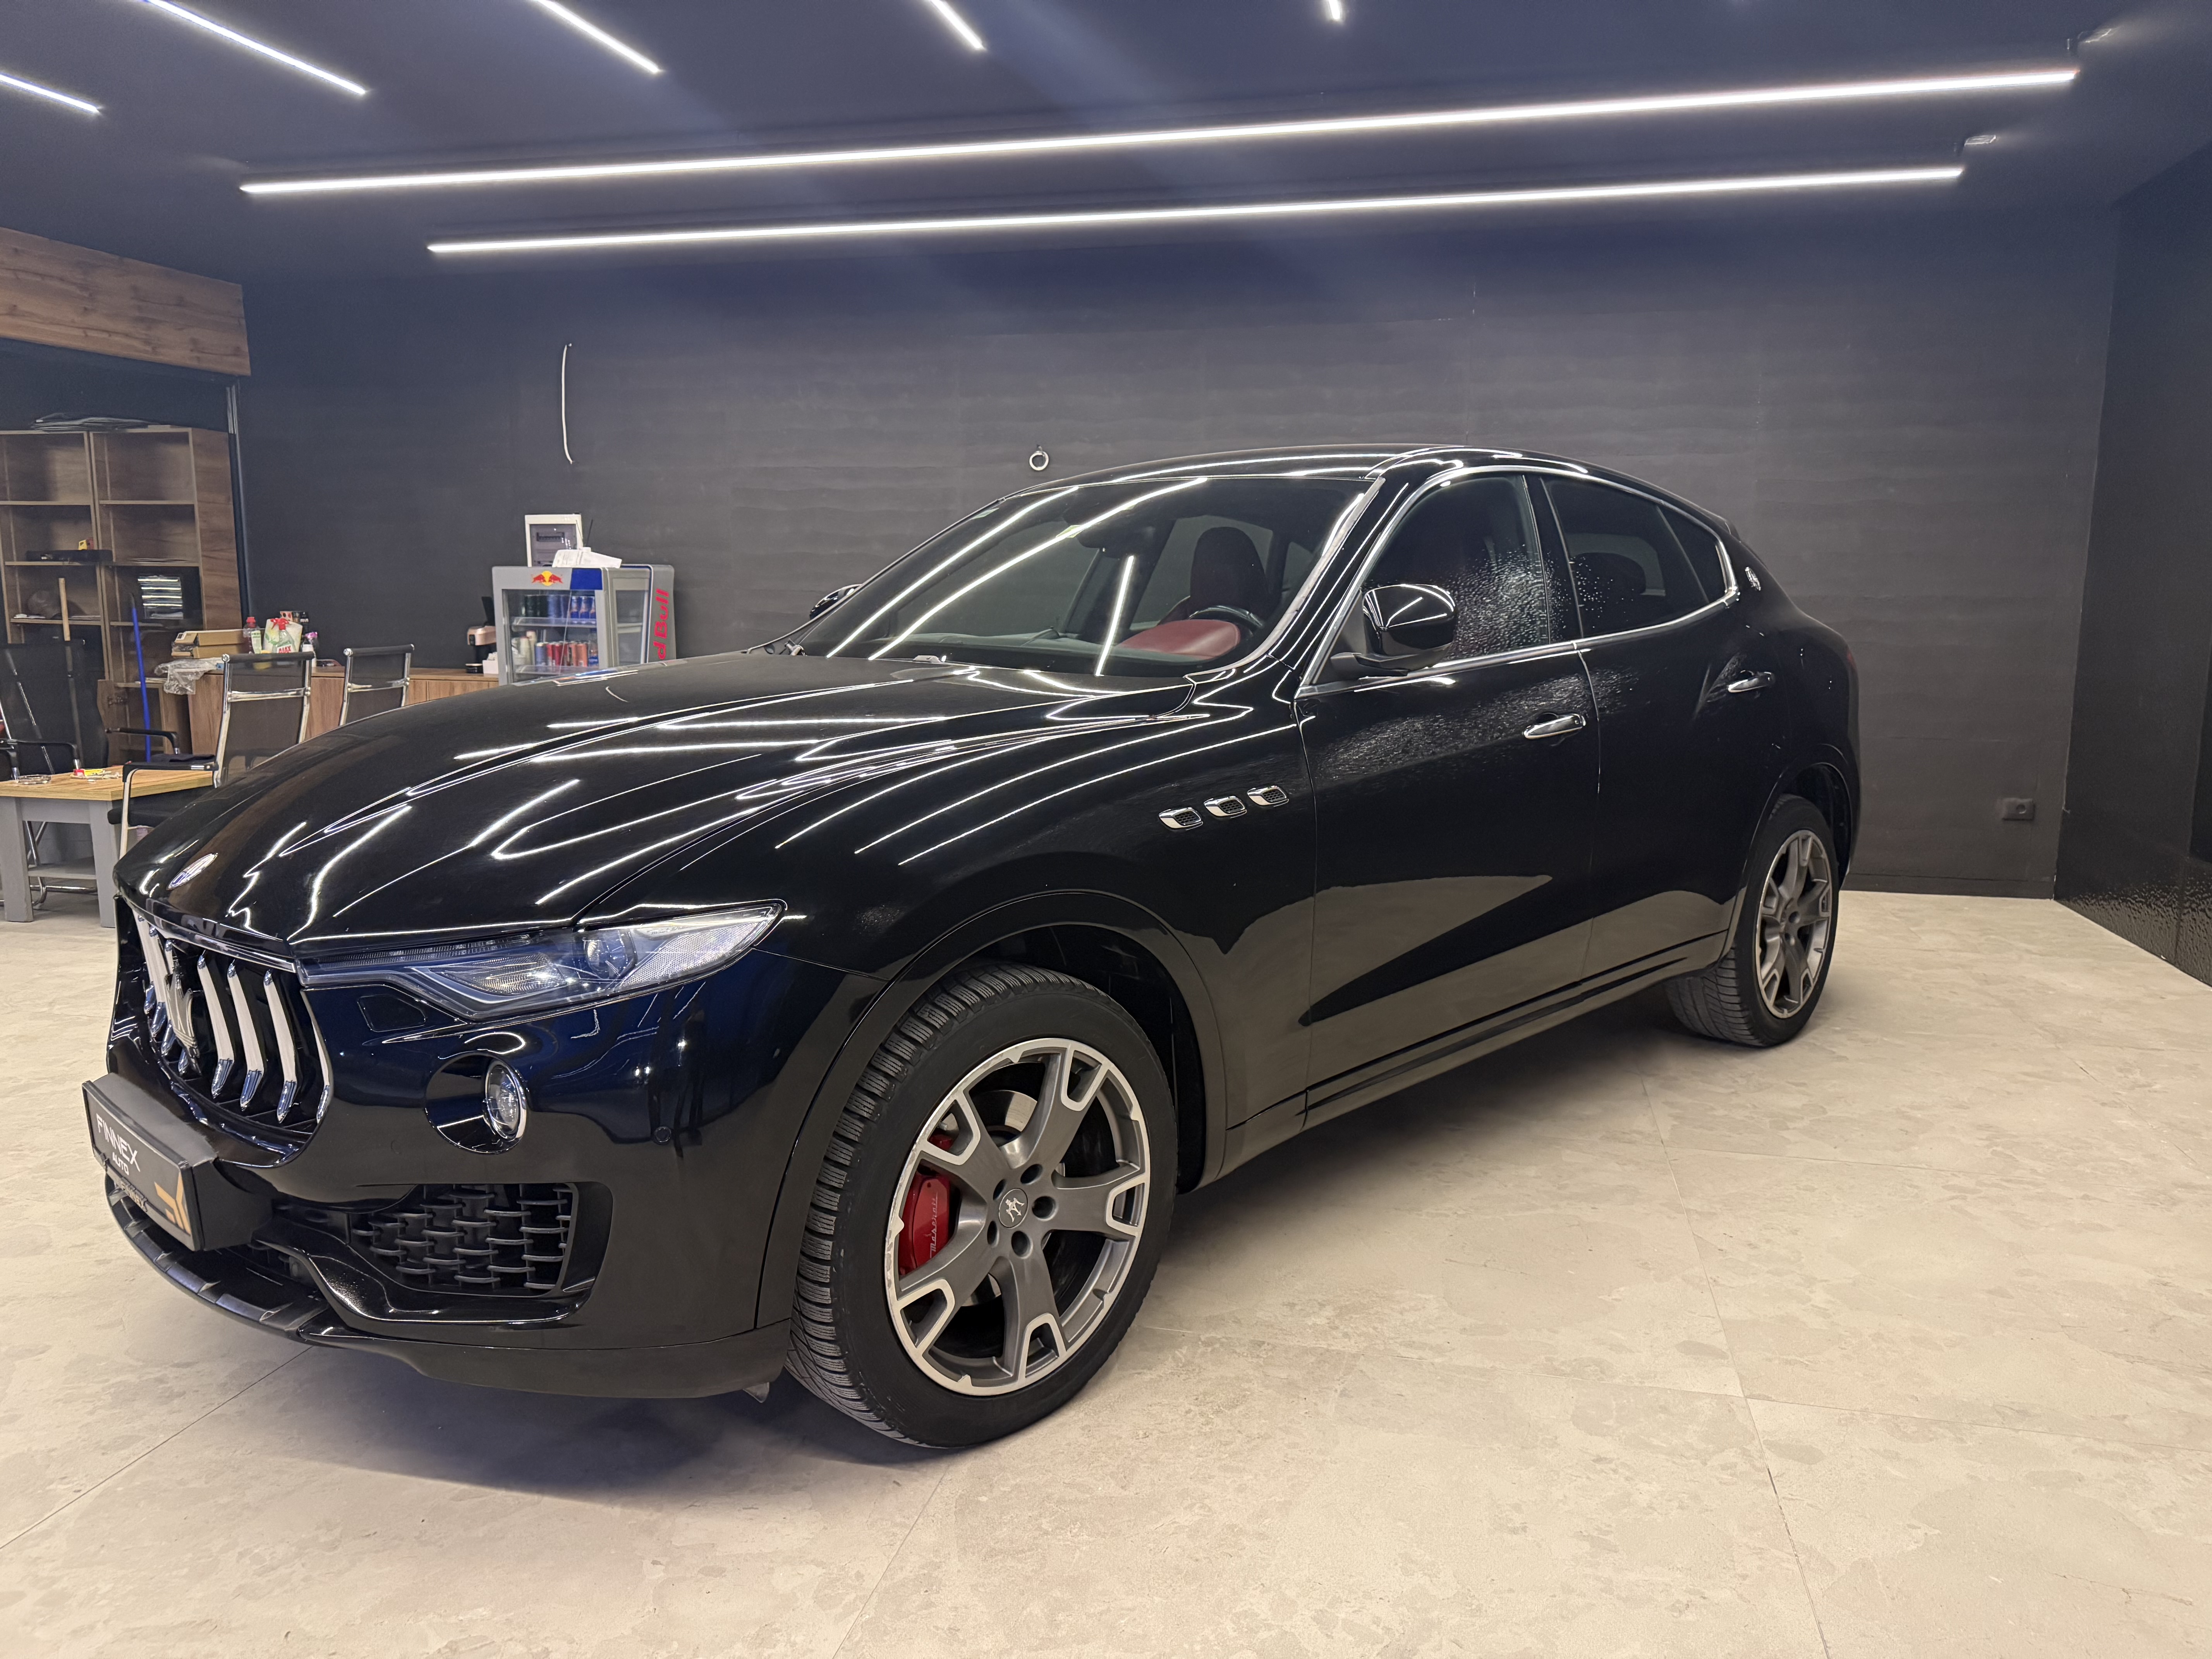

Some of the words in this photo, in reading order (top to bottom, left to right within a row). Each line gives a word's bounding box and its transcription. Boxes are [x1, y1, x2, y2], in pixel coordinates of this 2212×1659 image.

[654, 588, 670, 639] Bull
[96, 1113, 141, 1172] FINNEX
[112, 1152, 129, 1176] AUTO
